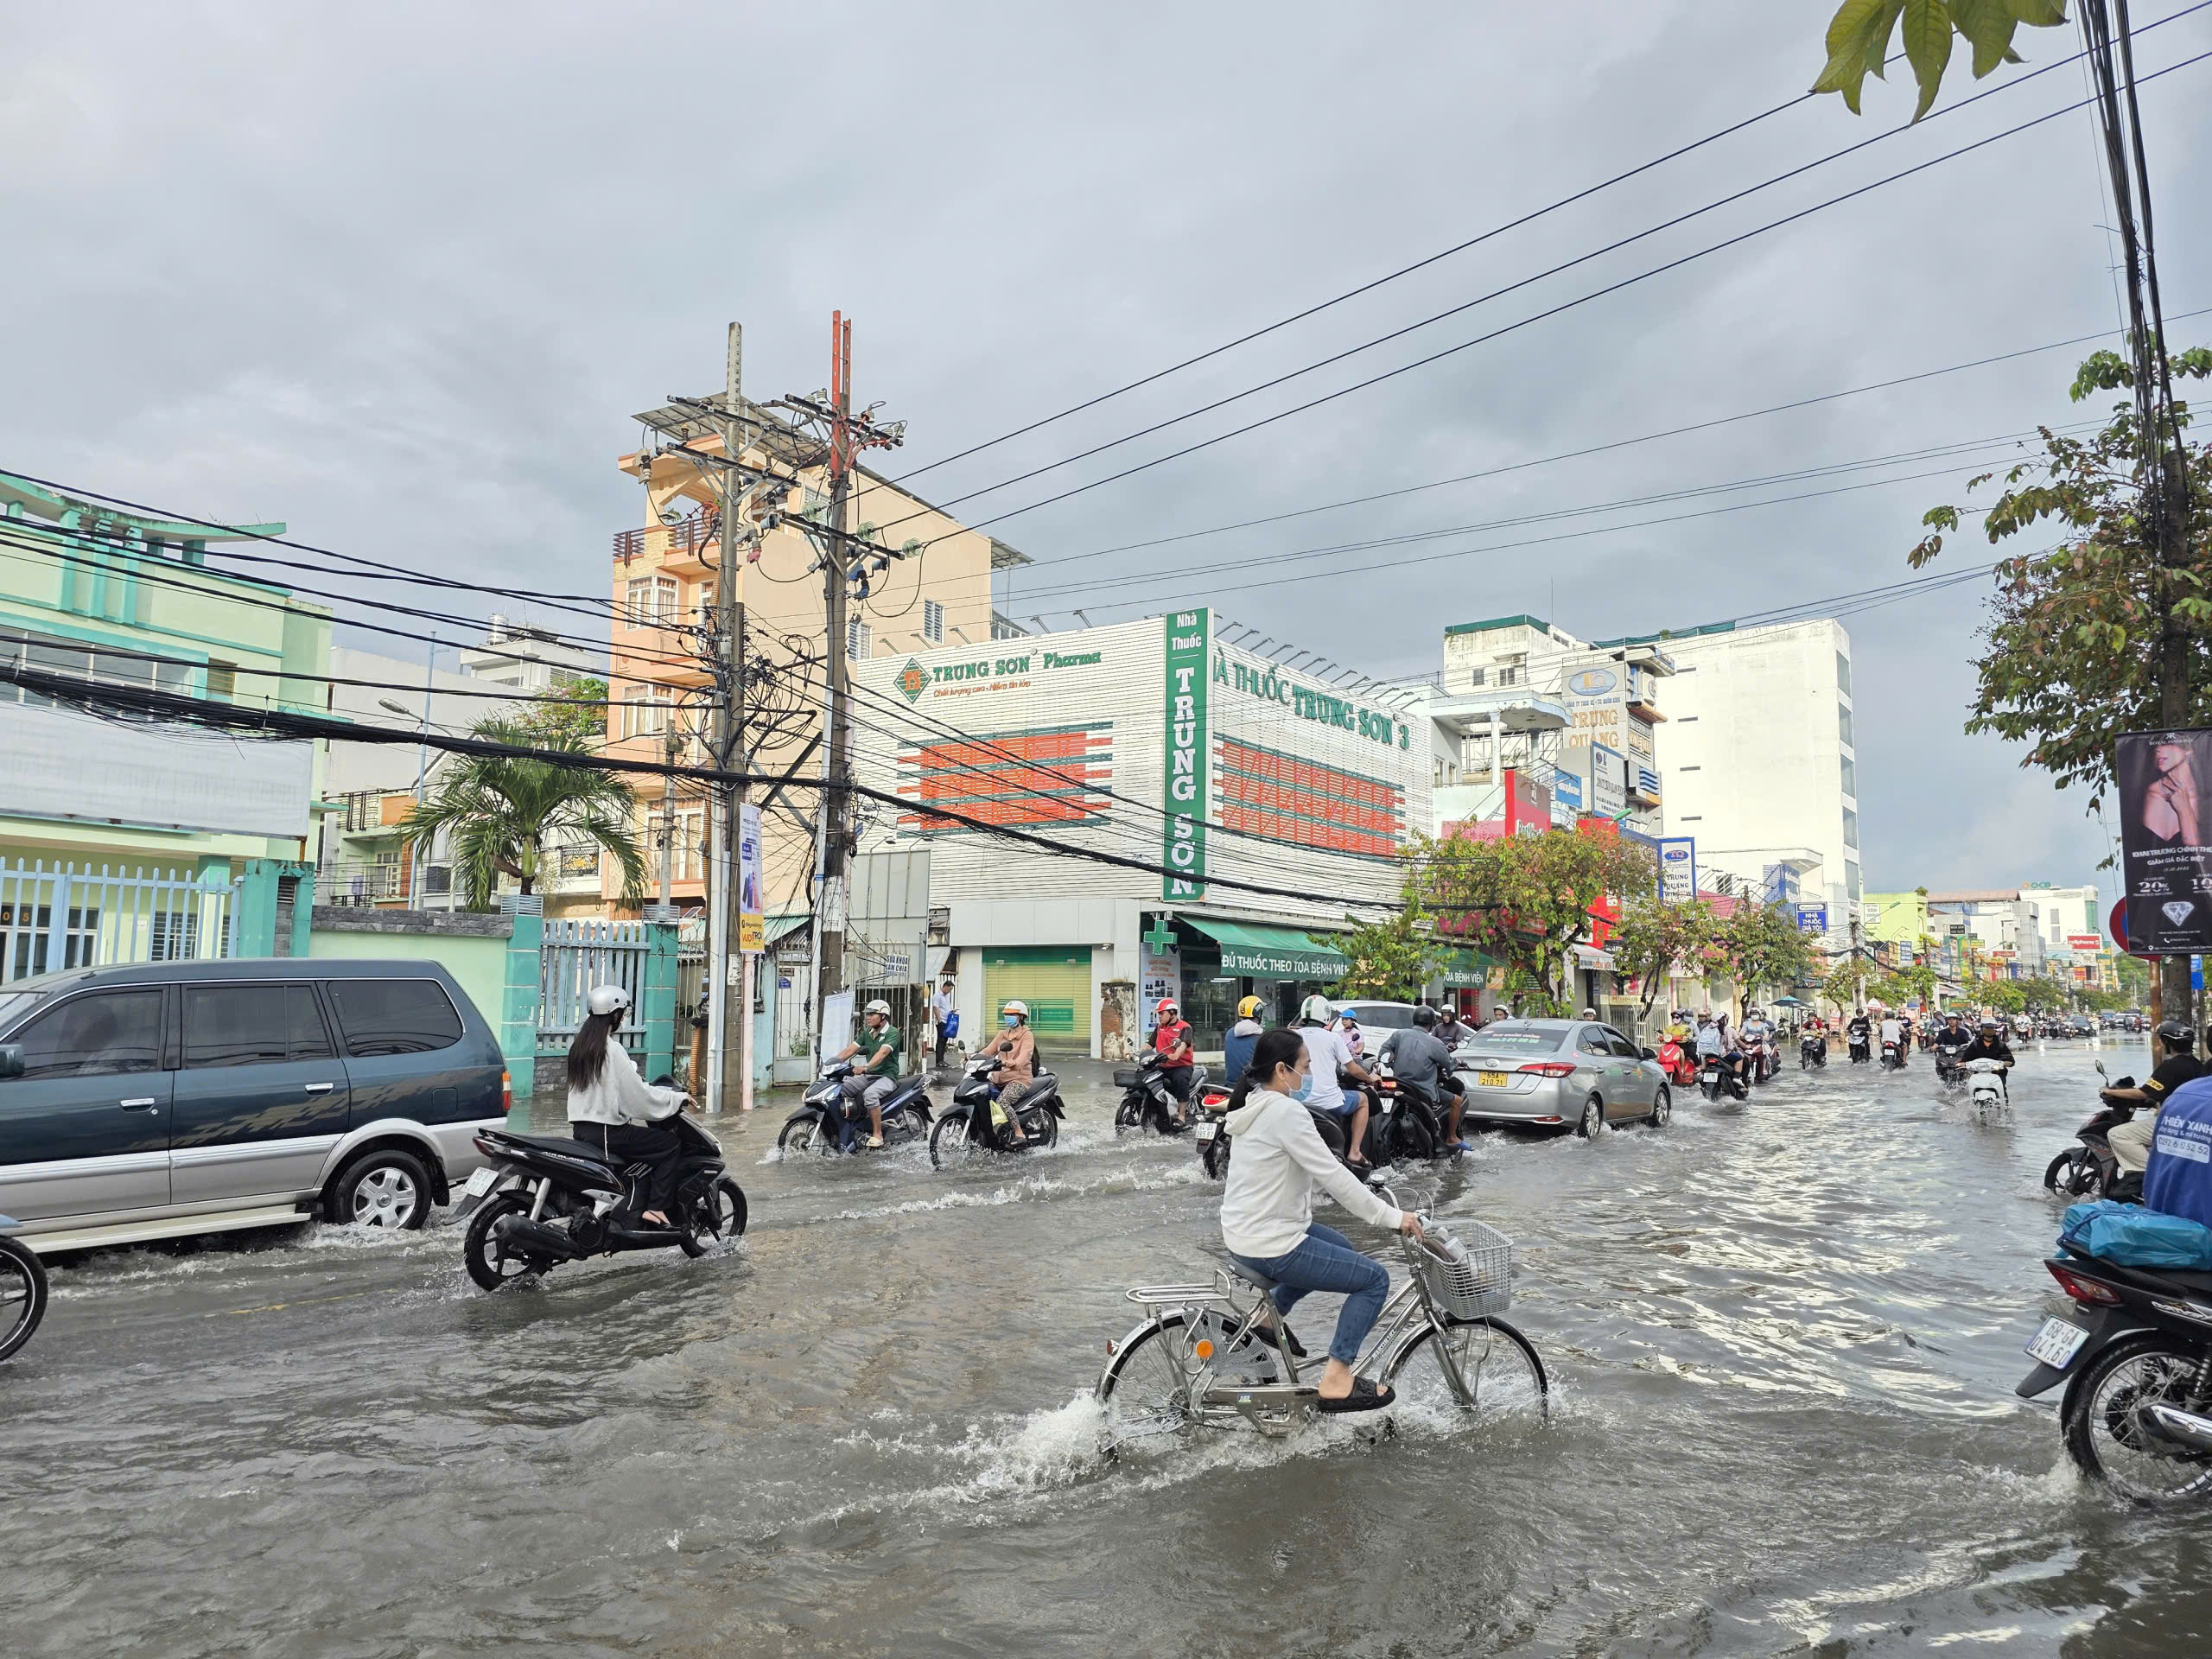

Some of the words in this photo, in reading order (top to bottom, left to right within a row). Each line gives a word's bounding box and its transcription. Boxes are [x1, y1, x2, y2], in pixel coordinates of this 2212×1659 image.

[1176, 613, 1198, 628] Nhà
[1172, 632, 1202, 651] Thuốc
[933, 660, 989, 683] TRUNG
[995, 656, 1031, 677] SƠN
[1043, 651, 1102, 669] Pharma
[1233, 663, 1290, 706] THUỐC
[1292, 683, 1355, 732] TRUNG
[1358, 708, 1393, 746] SƠN
[1398, 724, 1410, 751] 3
[1572, 708, 1618, 728] TRUNG
[1171, 666, 1197, 801] TRUNG
[1222, 950, 1236, 968] ĐỦ
[1237, 952, 1268, 970] THUỐC
[1268, 958, 1292, 972] THEO
[1294, 961, 1310, 974] TOA
[1311, 959, 1332, 977] BỆNH
[1454, 969, 1470, 985] BỆNH
[1471, 970, 1484, 986] VIỆN
[2172, 1139, 2178, 1148] 6
[2186, 1143, 2196, 1152] 52
[2197, 1147, 2209, 1155] 52
[2029, 1336, 2072, 1365] 041.60
